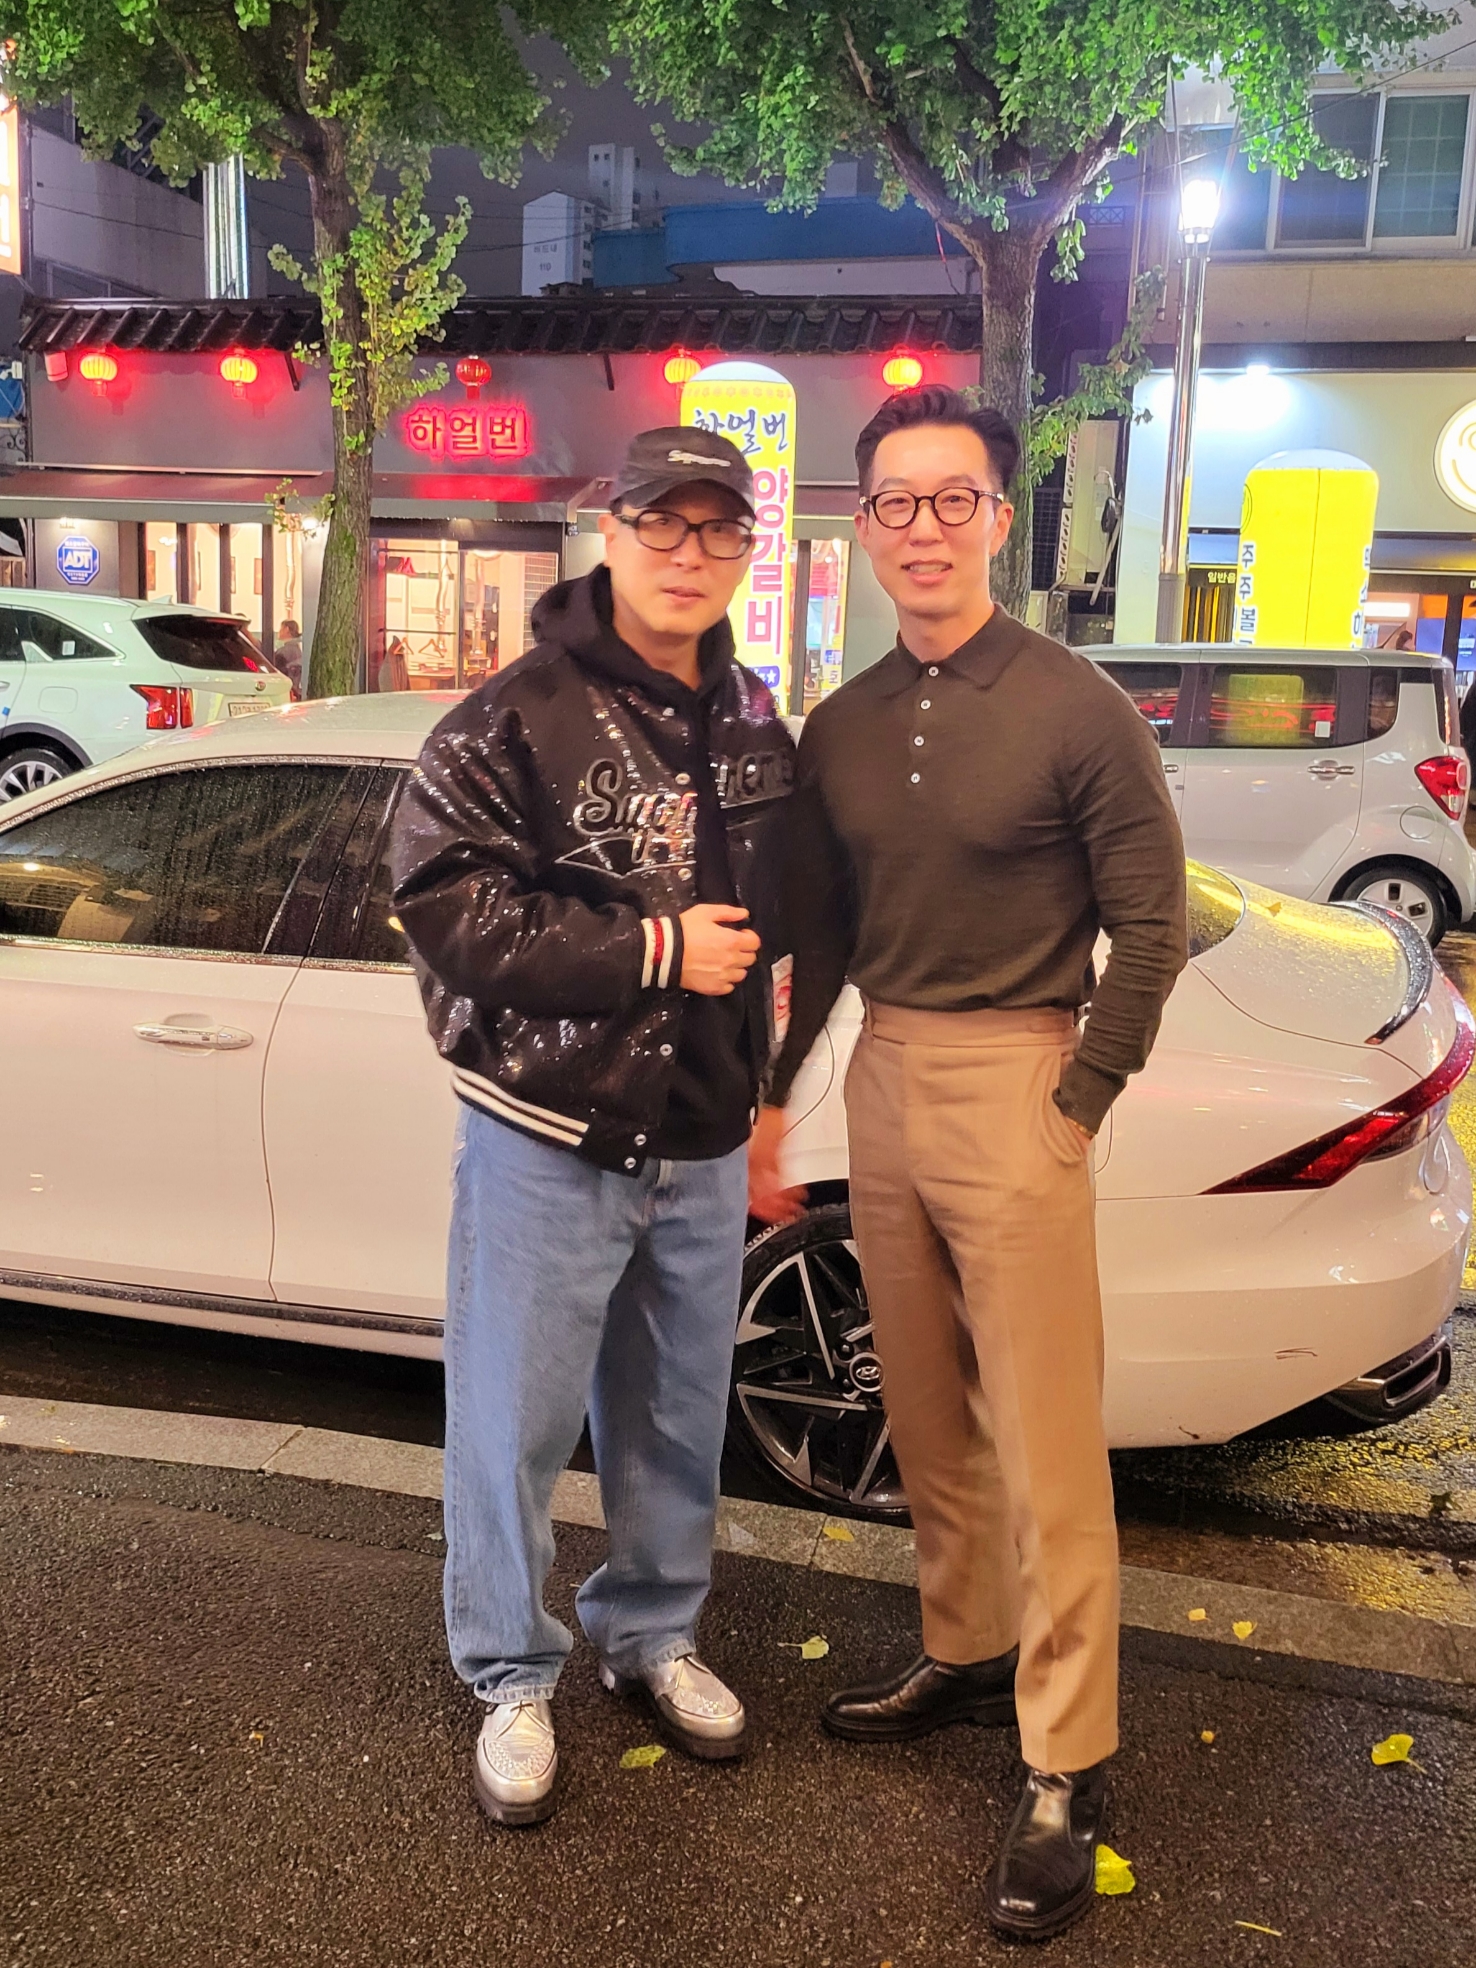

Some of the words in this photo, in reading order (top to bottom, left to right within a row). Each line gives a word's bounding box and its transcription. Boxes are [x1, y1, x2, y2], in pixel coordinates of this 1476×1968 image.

[409, 412, 520, 452] 하얼번
[64, 550, 91, 569] ADT
[746, 467, 789, 656] 양갈비
[1239, 544, 1256, 646] 주주볼
